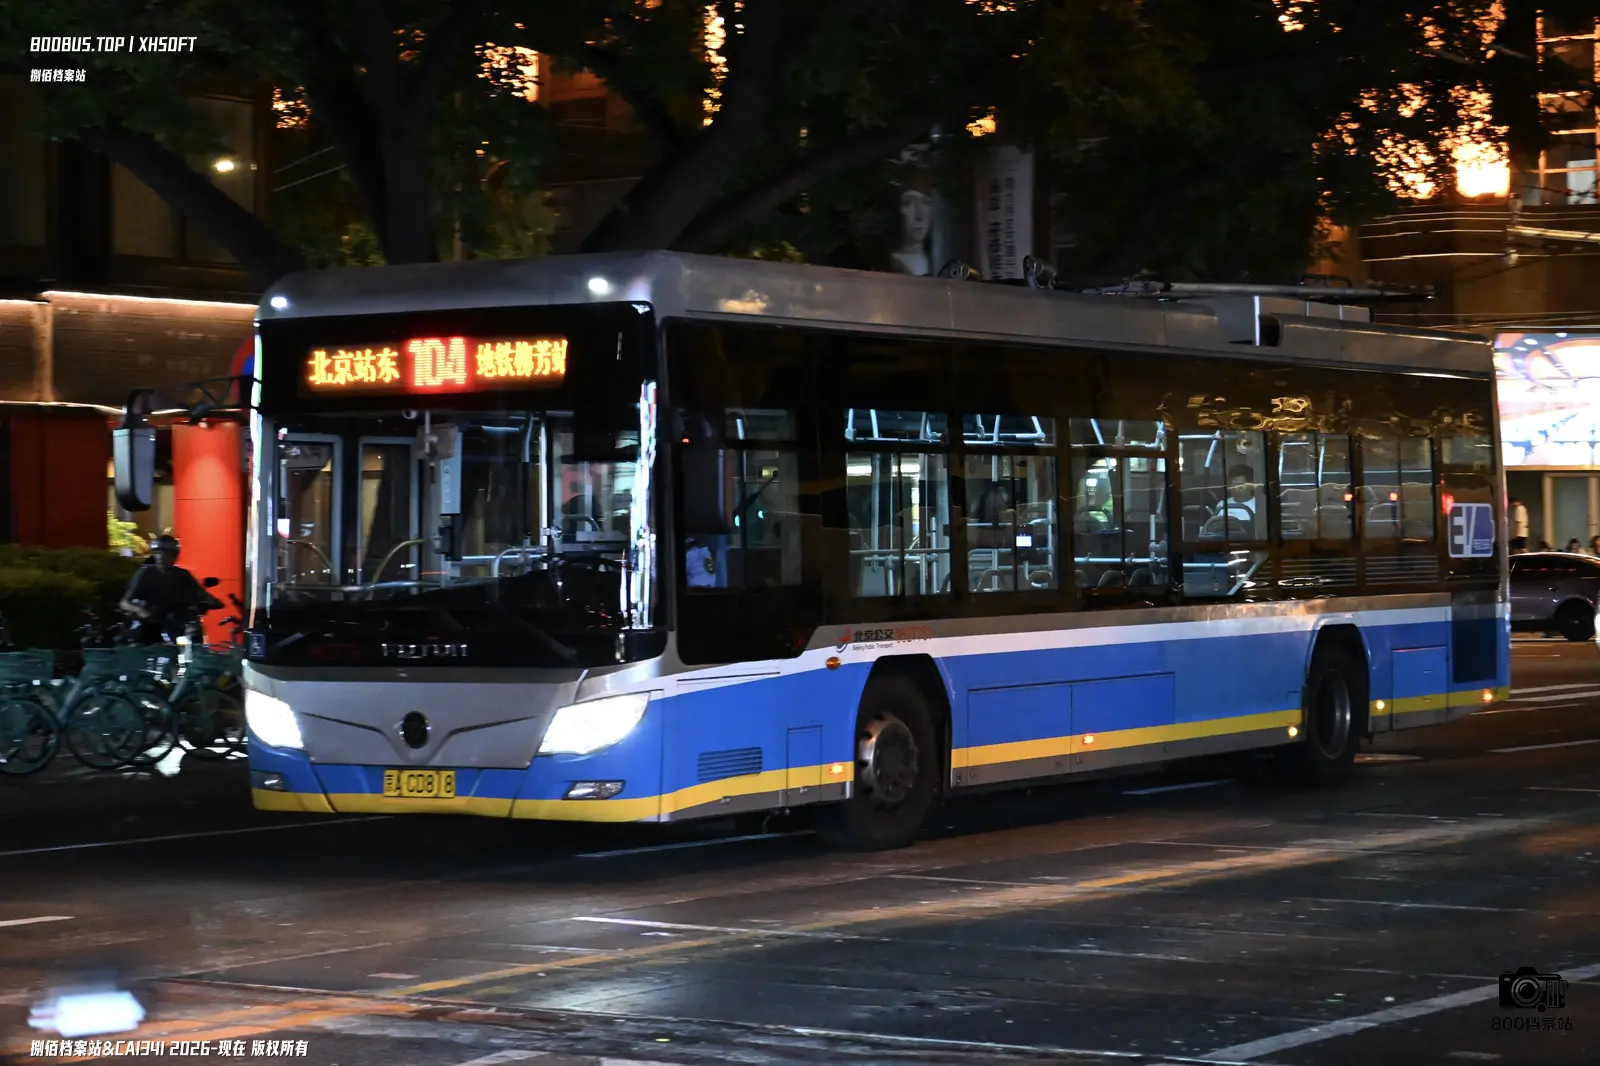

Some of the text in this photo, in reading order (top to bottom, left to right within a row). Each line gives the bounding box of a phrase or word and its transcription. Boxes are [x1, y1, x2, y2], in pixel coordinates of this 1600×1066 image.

[308, 347, 400, 385] 北京站东
[407, 337, 467, 387] 104
[854, 628, 894, 642] 北京公交
